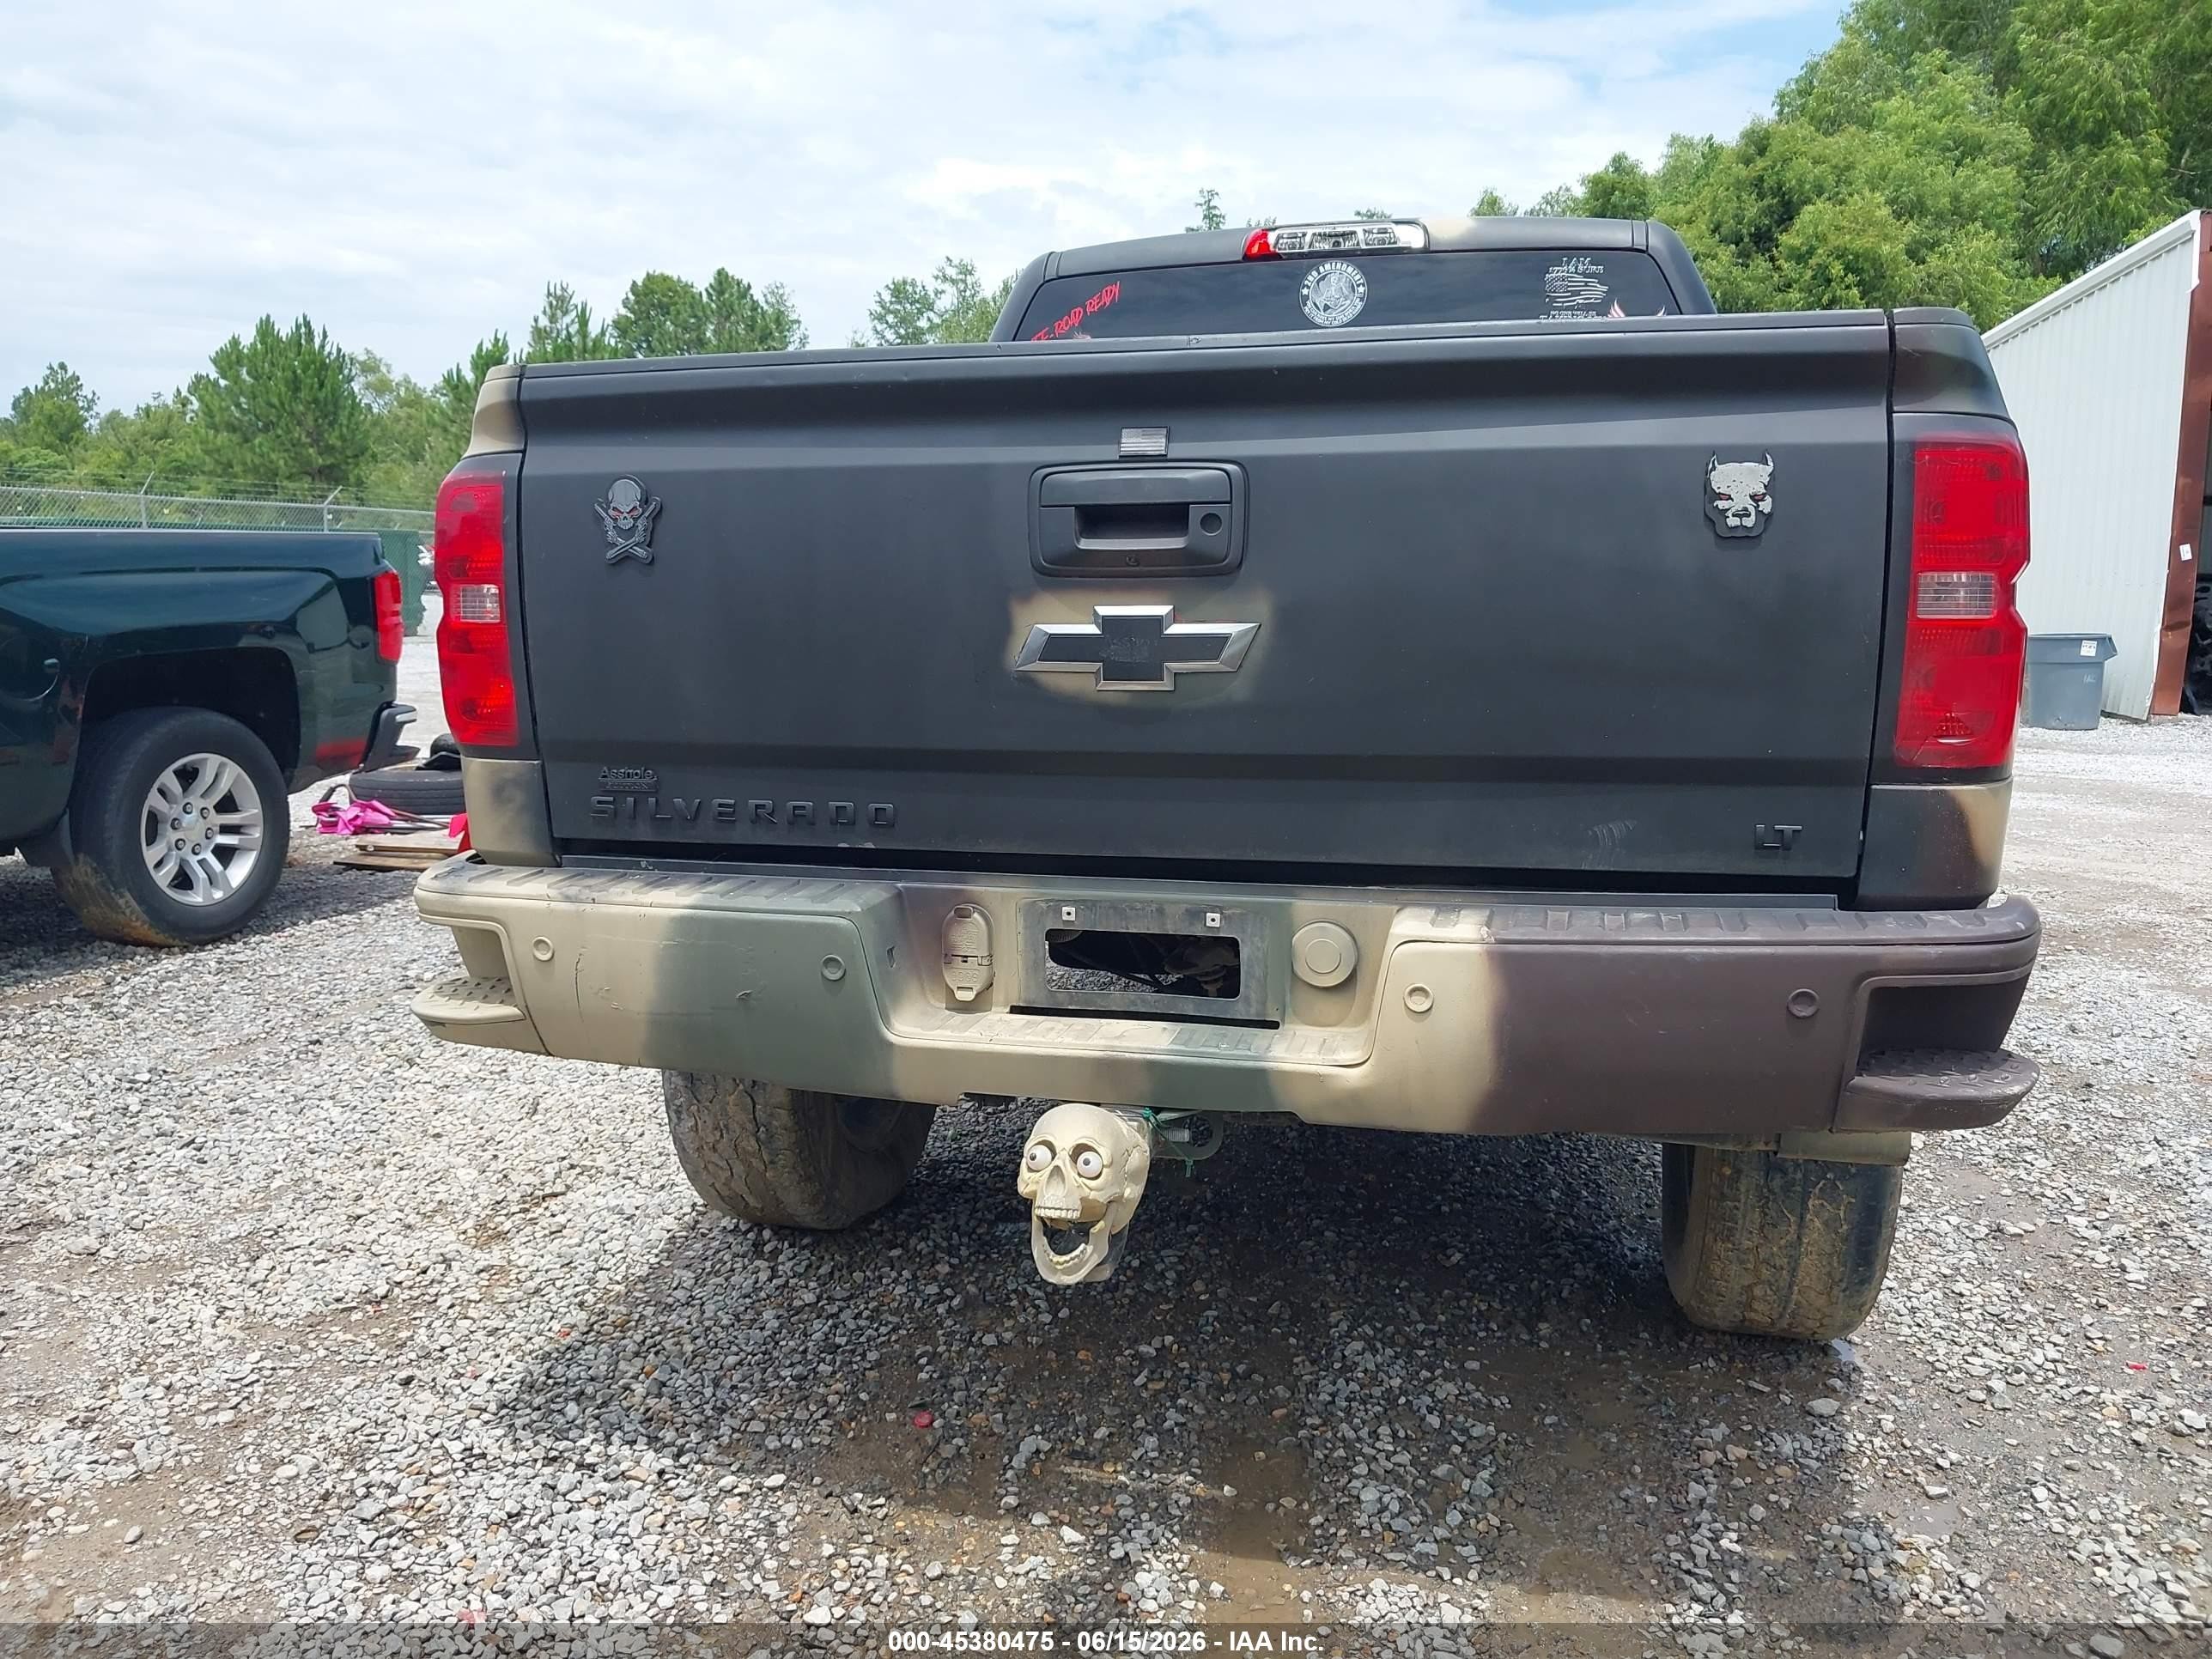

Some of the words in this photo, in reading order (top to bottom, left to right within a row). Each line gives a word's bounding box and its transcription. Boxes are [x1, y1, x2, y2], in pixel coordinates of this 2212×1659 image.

[1319, 262, 1364, 284] AMENDMENT
[1085, 281, 1120, 316] READY
[590, 795, 896, 826] SILVERADO
[1754, 824, 1802, 850] LT
